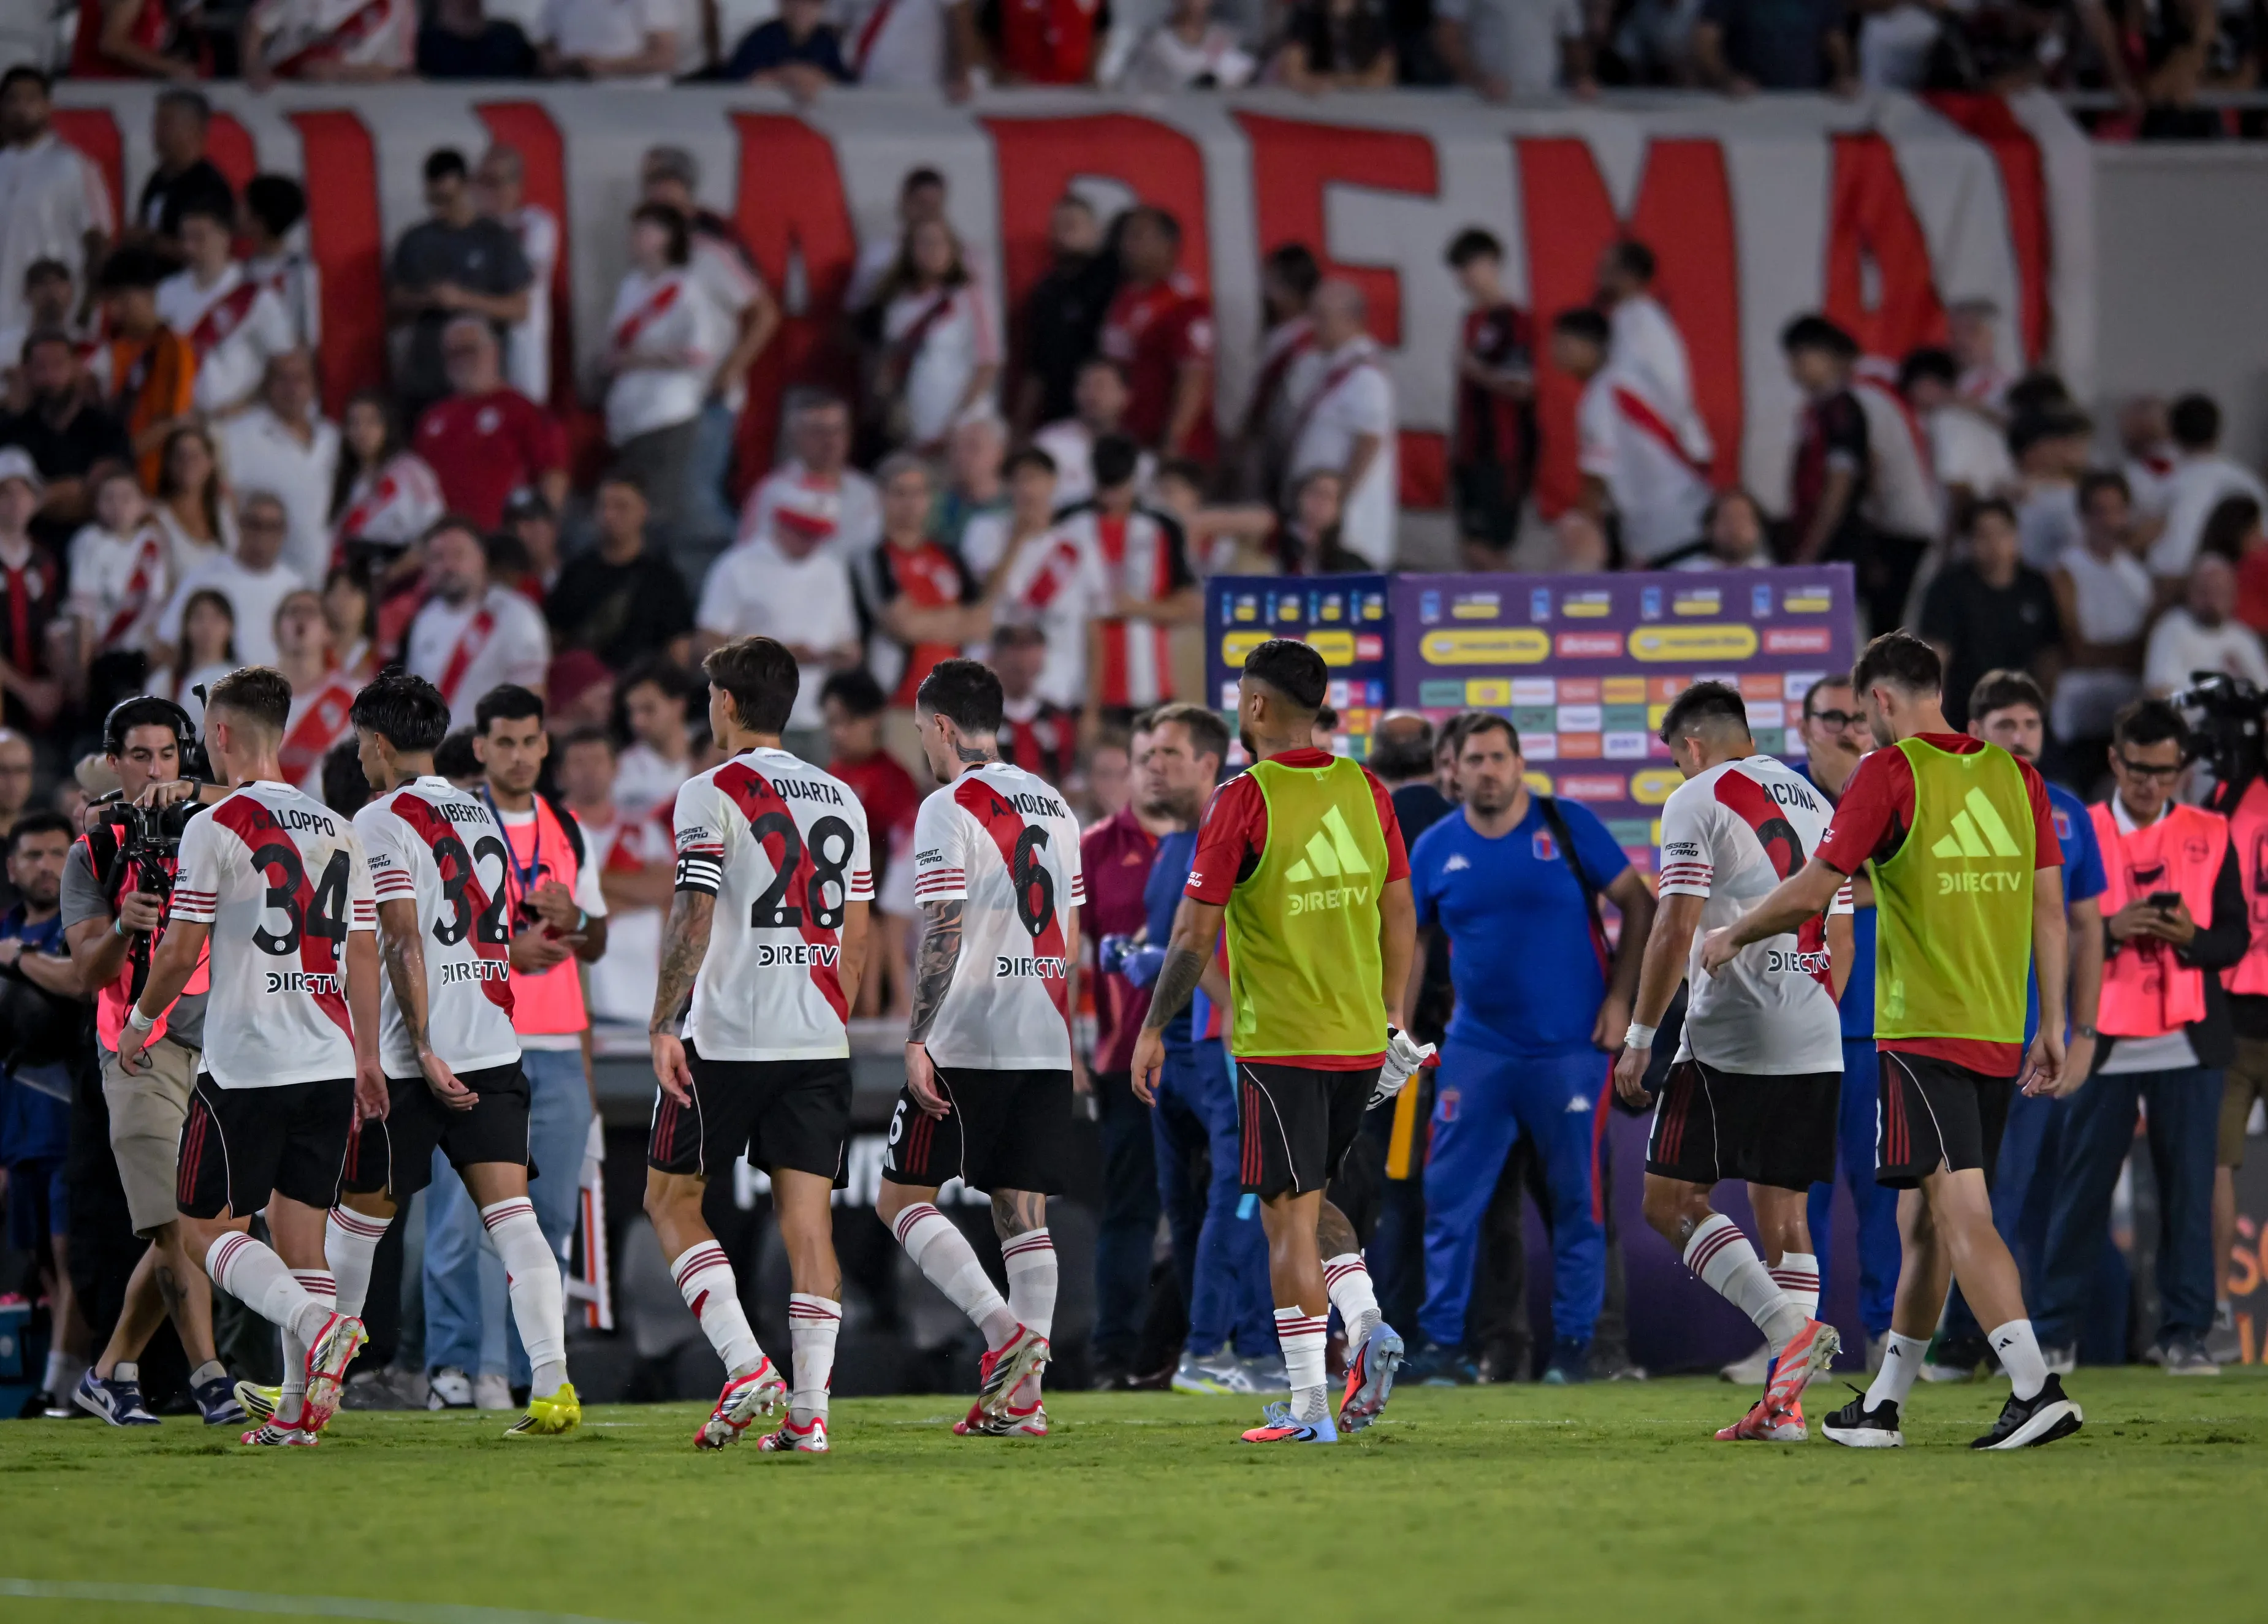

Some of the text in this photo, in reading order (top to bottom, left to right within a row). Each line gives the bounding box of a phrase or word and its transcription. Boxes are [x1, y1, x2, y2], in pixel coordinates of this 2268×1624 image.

[772, 778, 844, 806] QUARTA
[1762, 782, 1819, 813] ACUÑA
[251, 810, 335, 838] GALOPPO
[425, 803, 490, 825] RUBERTO
[369, 860, 391, 871] ARD
[915, 848, 940, 860] SSIST
[676, 859, 685, 885] C
[750, 812, 855, 930] 28
[1013, 824, 1054, 938] 6
[250, 843, 351, 962] 34
[432, 835, 510, 947] 32
[265, 971, 339, 995] DIRCTV
[441, 959, 510, 986] DIRETV
[889, 1099, 908, 1145] 6
